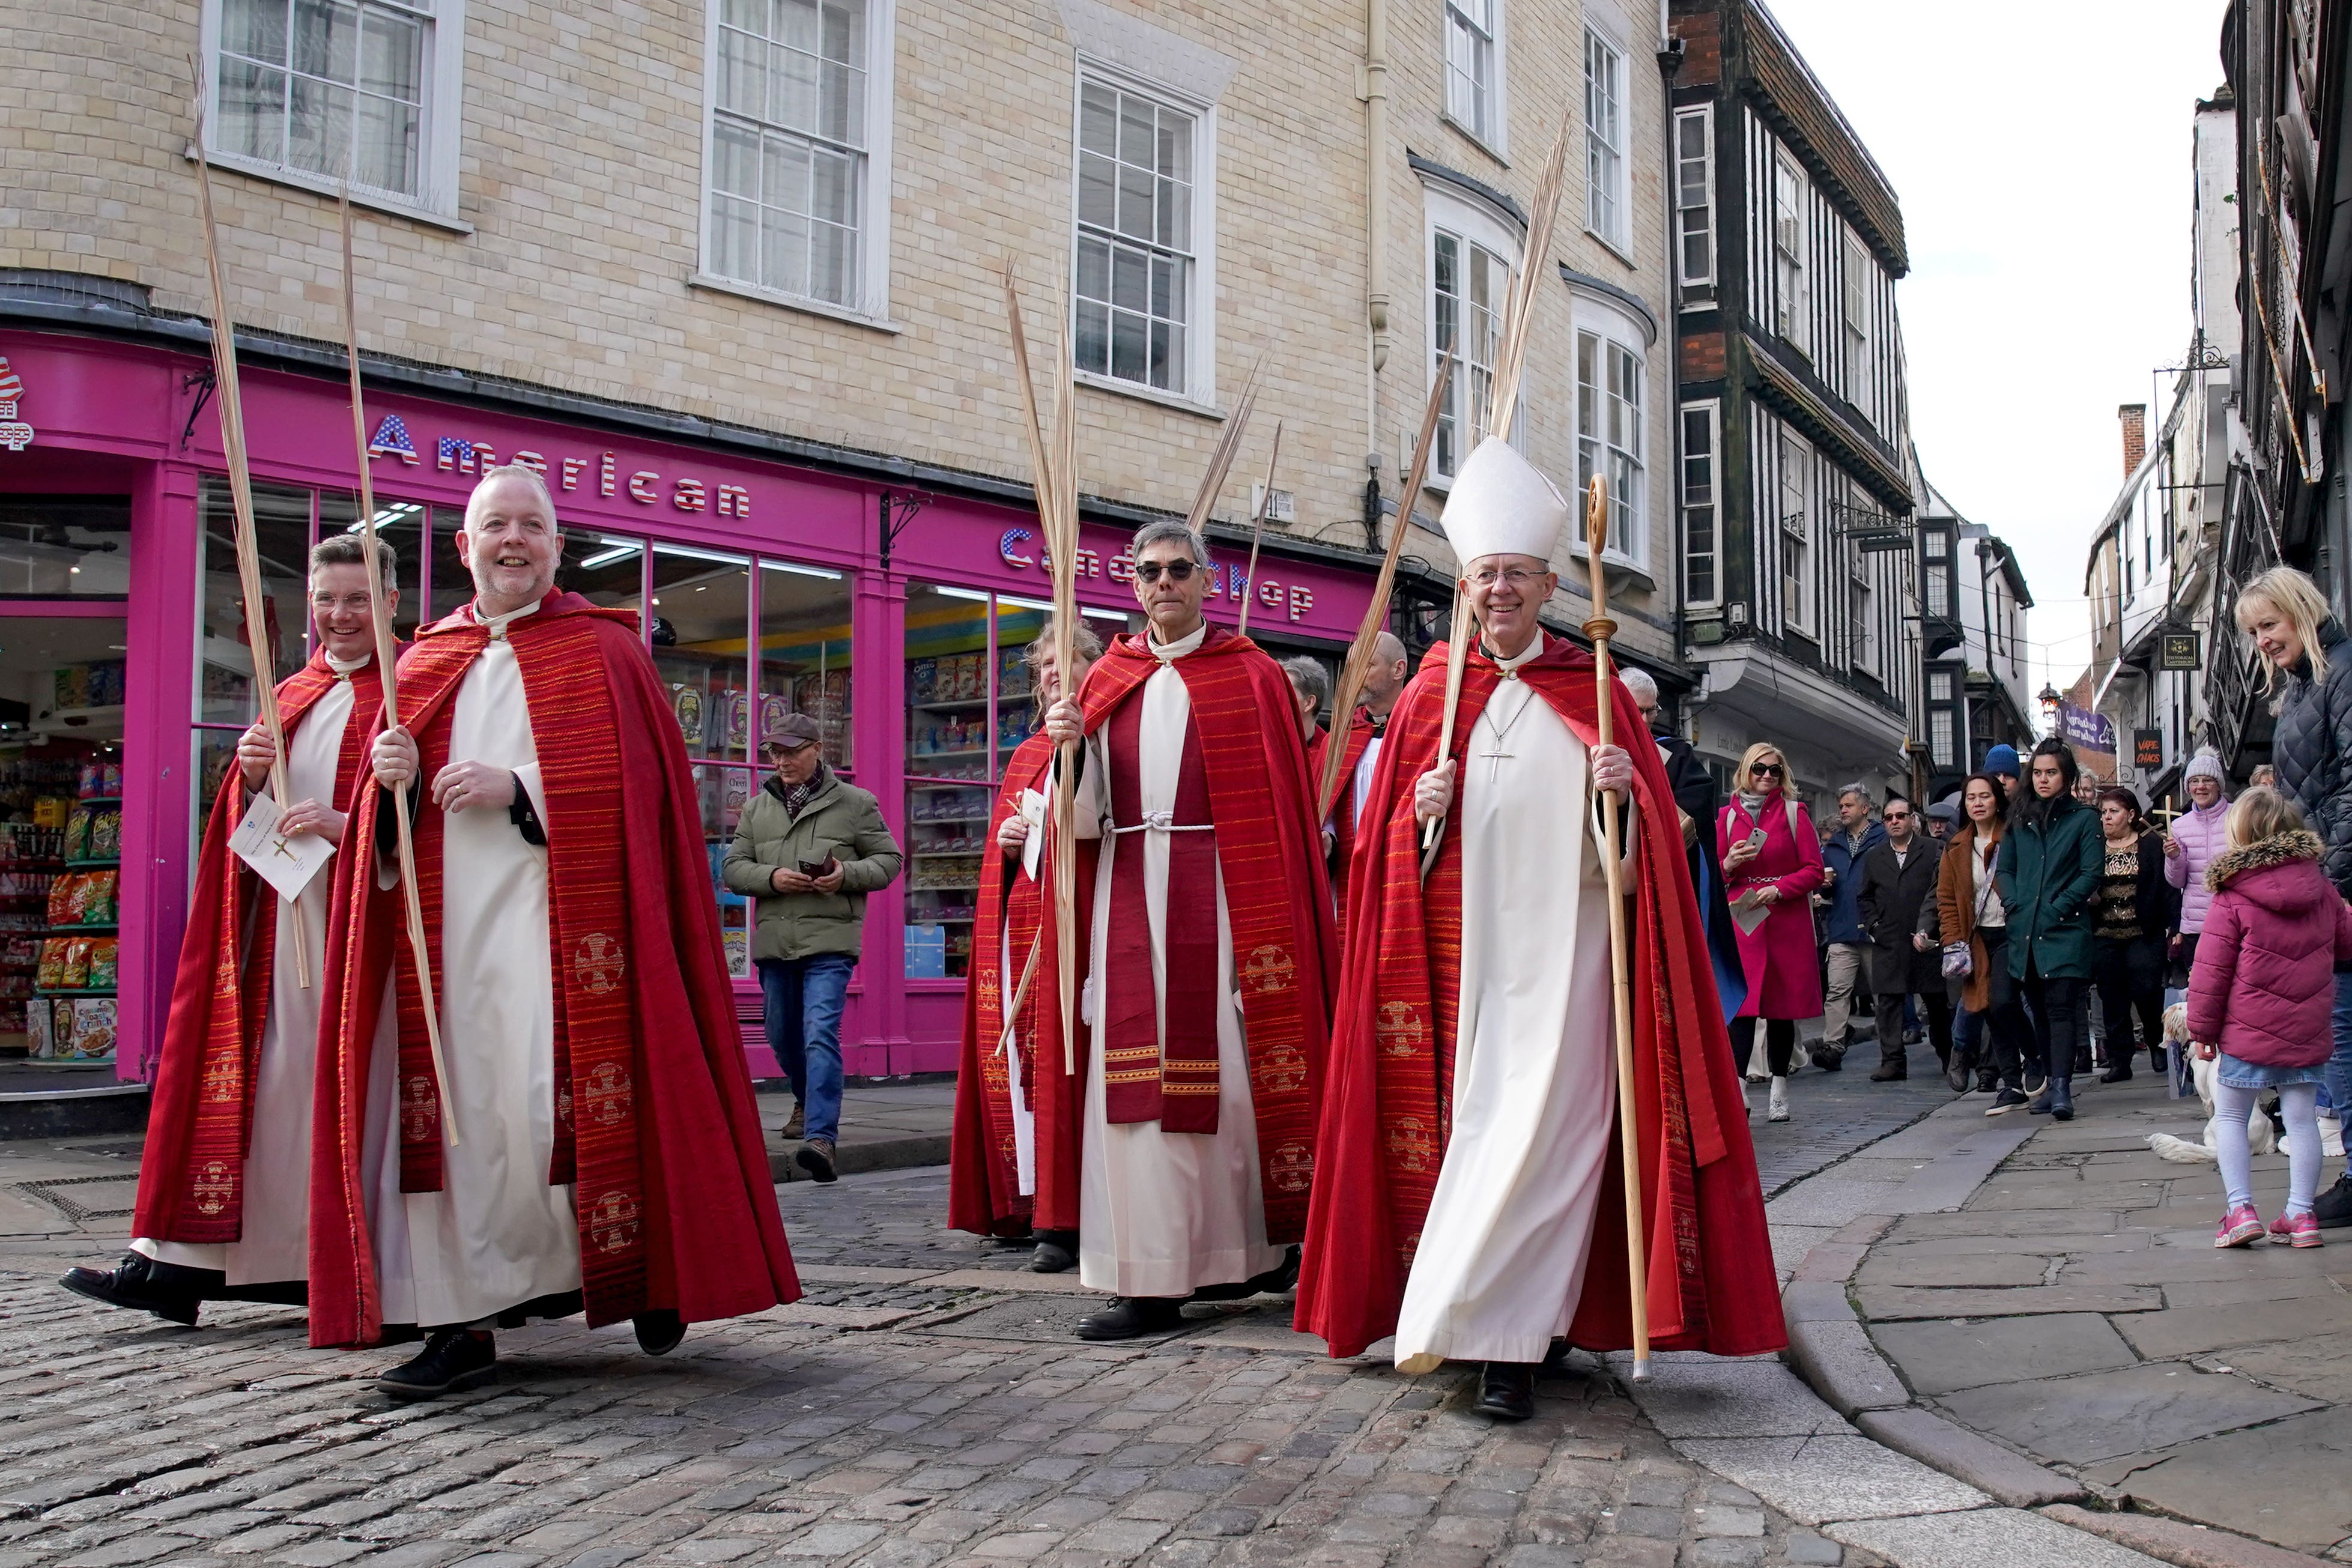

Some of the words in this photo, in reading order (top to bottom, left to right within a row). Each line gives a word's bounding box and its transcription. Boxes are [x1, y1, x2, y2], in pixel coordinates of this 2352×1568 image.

[0, 424, 32, 449] op
[368, 414, 750, 518] American
[1001, 528, 1135, 583] Cnd
[2136, 752, 2160, 764] CHAOS
[2138, 740, 2159, 751] VAPE
